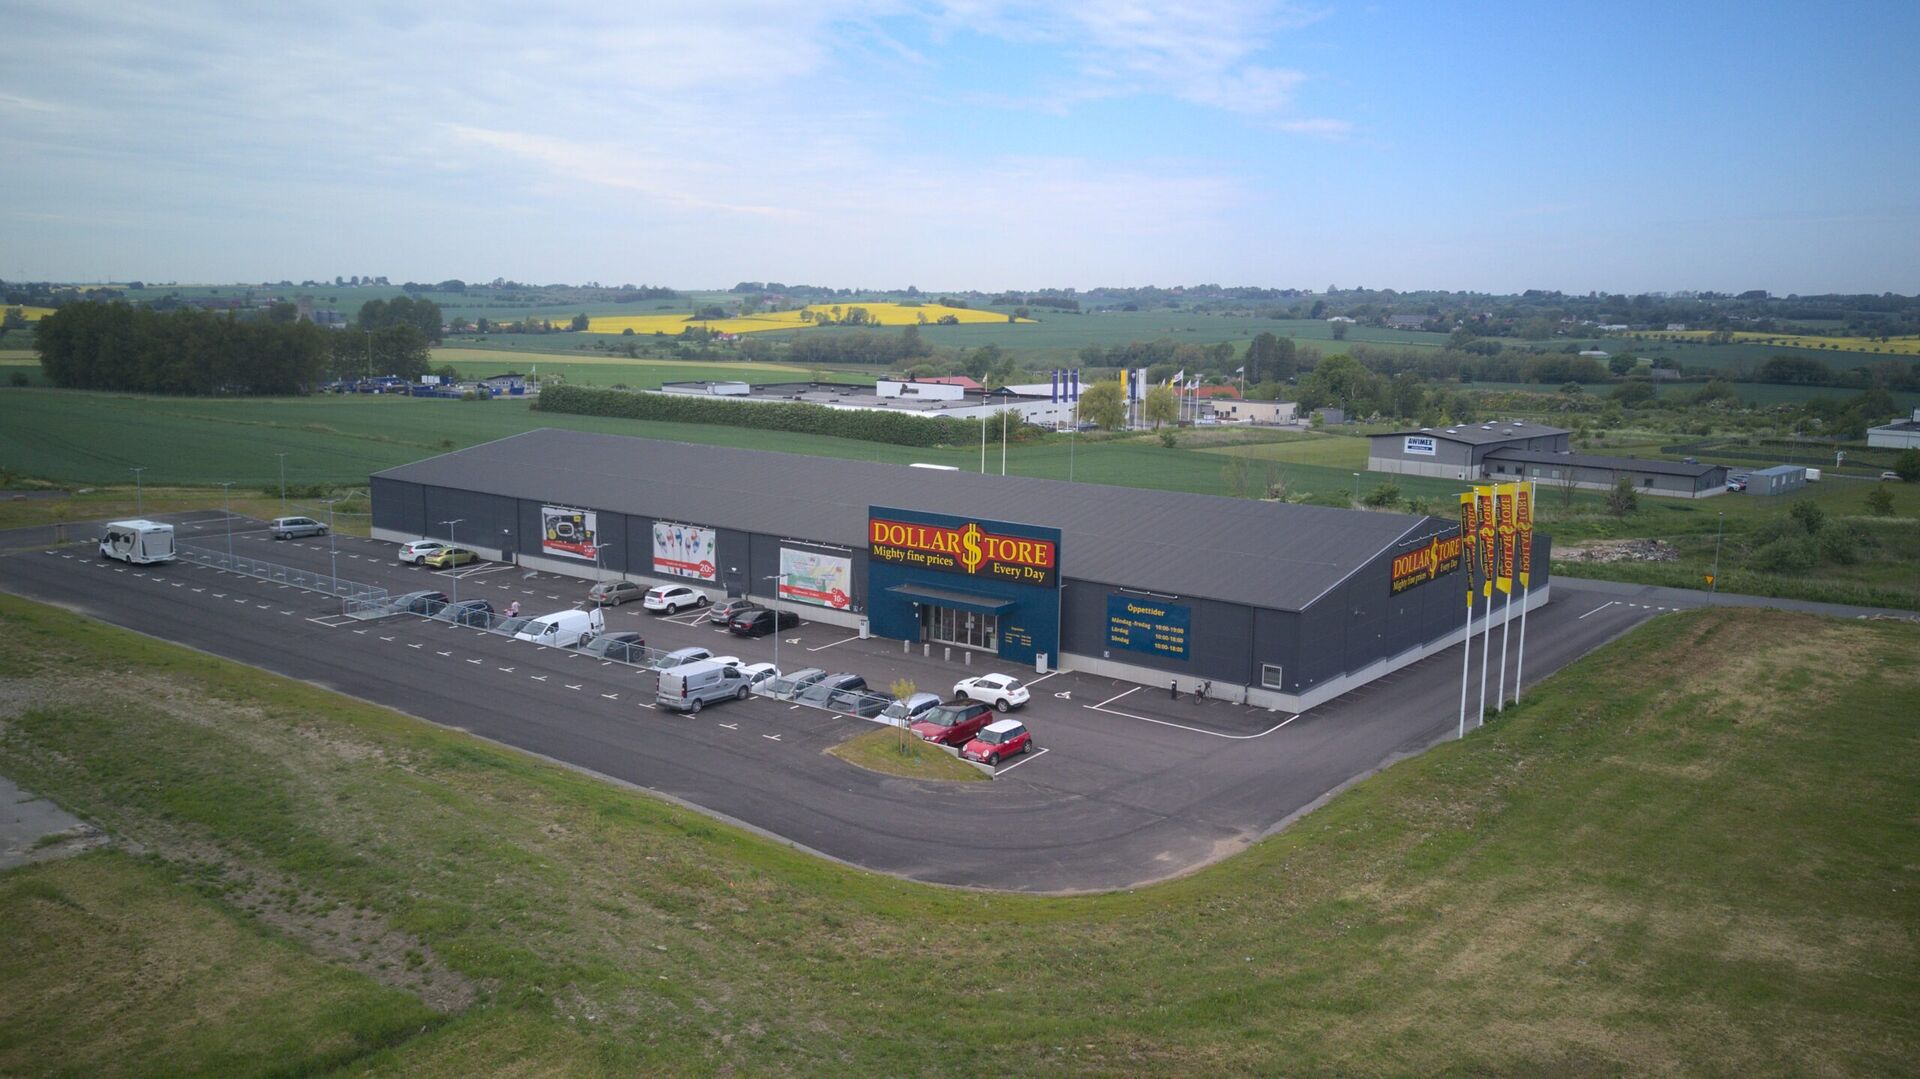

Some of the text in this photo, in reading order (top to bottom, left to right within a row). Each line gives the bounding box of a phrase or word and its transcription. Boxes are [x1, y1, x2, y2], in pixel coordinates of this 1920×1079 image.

[873, 545, 954, 567] Mighty fine prices
[993, 562, 1045, 582] Every Day
[1127, 603, 1166, 617] Öppettider
